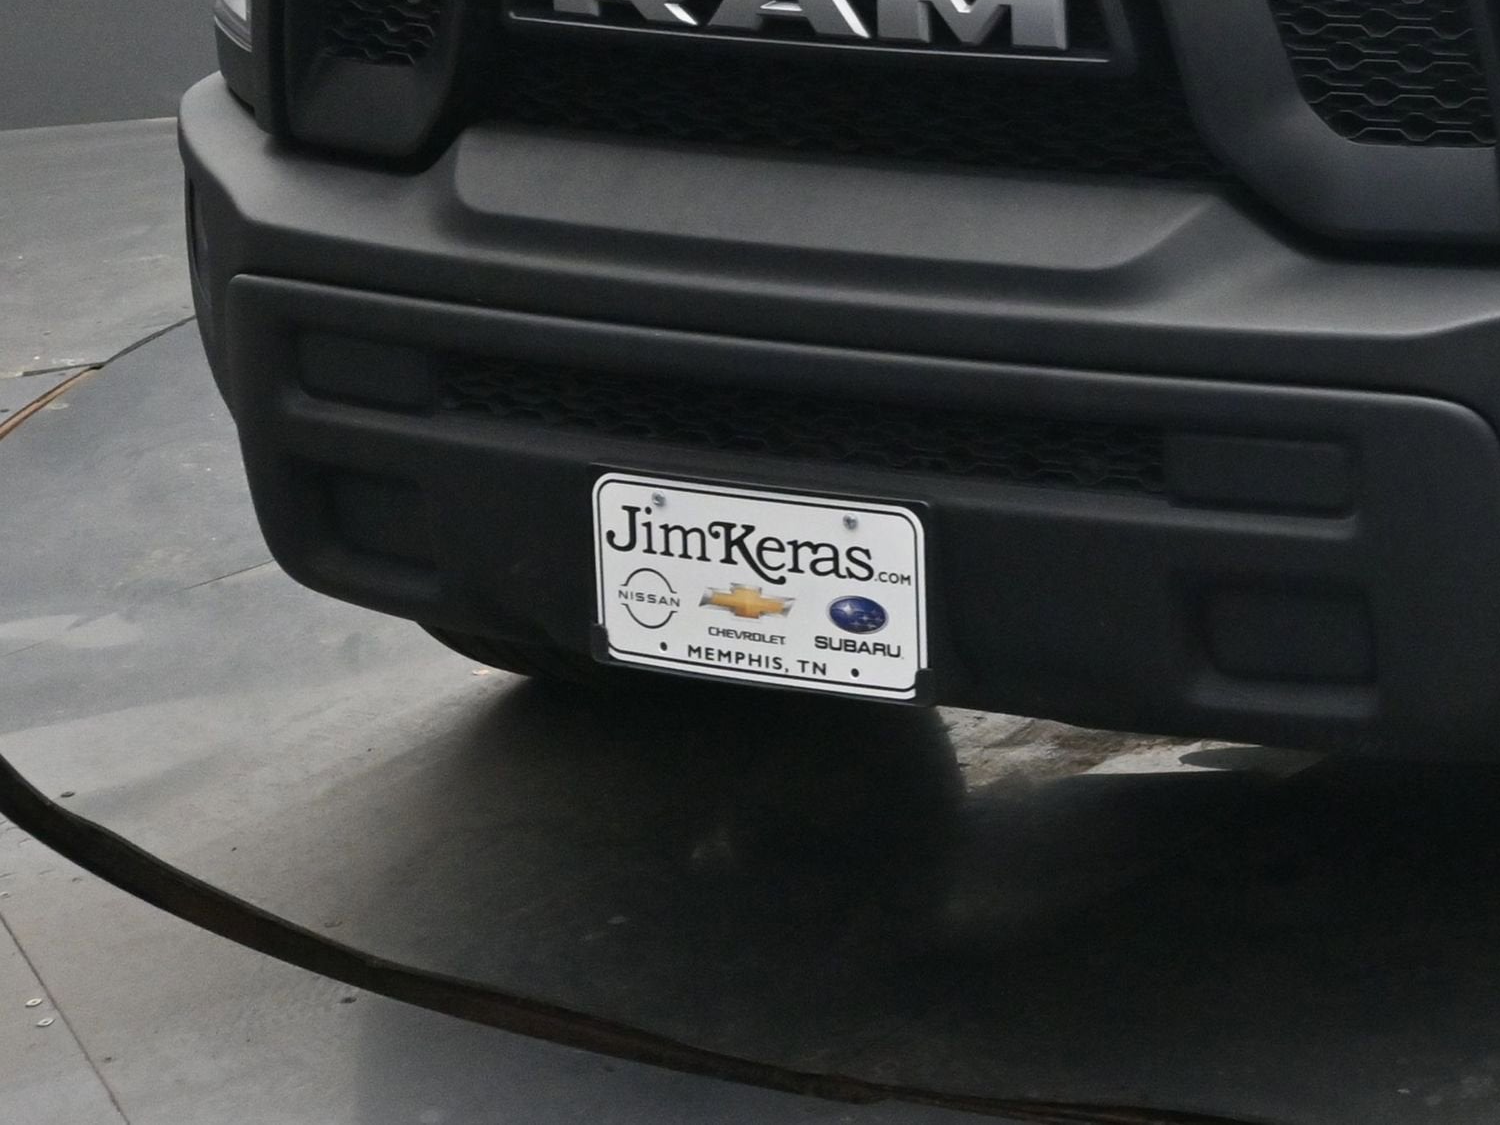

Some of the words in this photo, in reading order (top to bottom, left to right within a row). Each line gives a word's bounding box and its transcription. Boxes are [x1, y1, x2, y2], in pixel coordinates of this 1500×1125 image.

[618, 589, 681, 608] NISSAN
[708, 626, 786, 646] CHEVROLET
[814, 636, 901, 658] SUBARU
[687, 645, 789, 673] MEMPHIS,
[797, 660, 827, 676] TN
